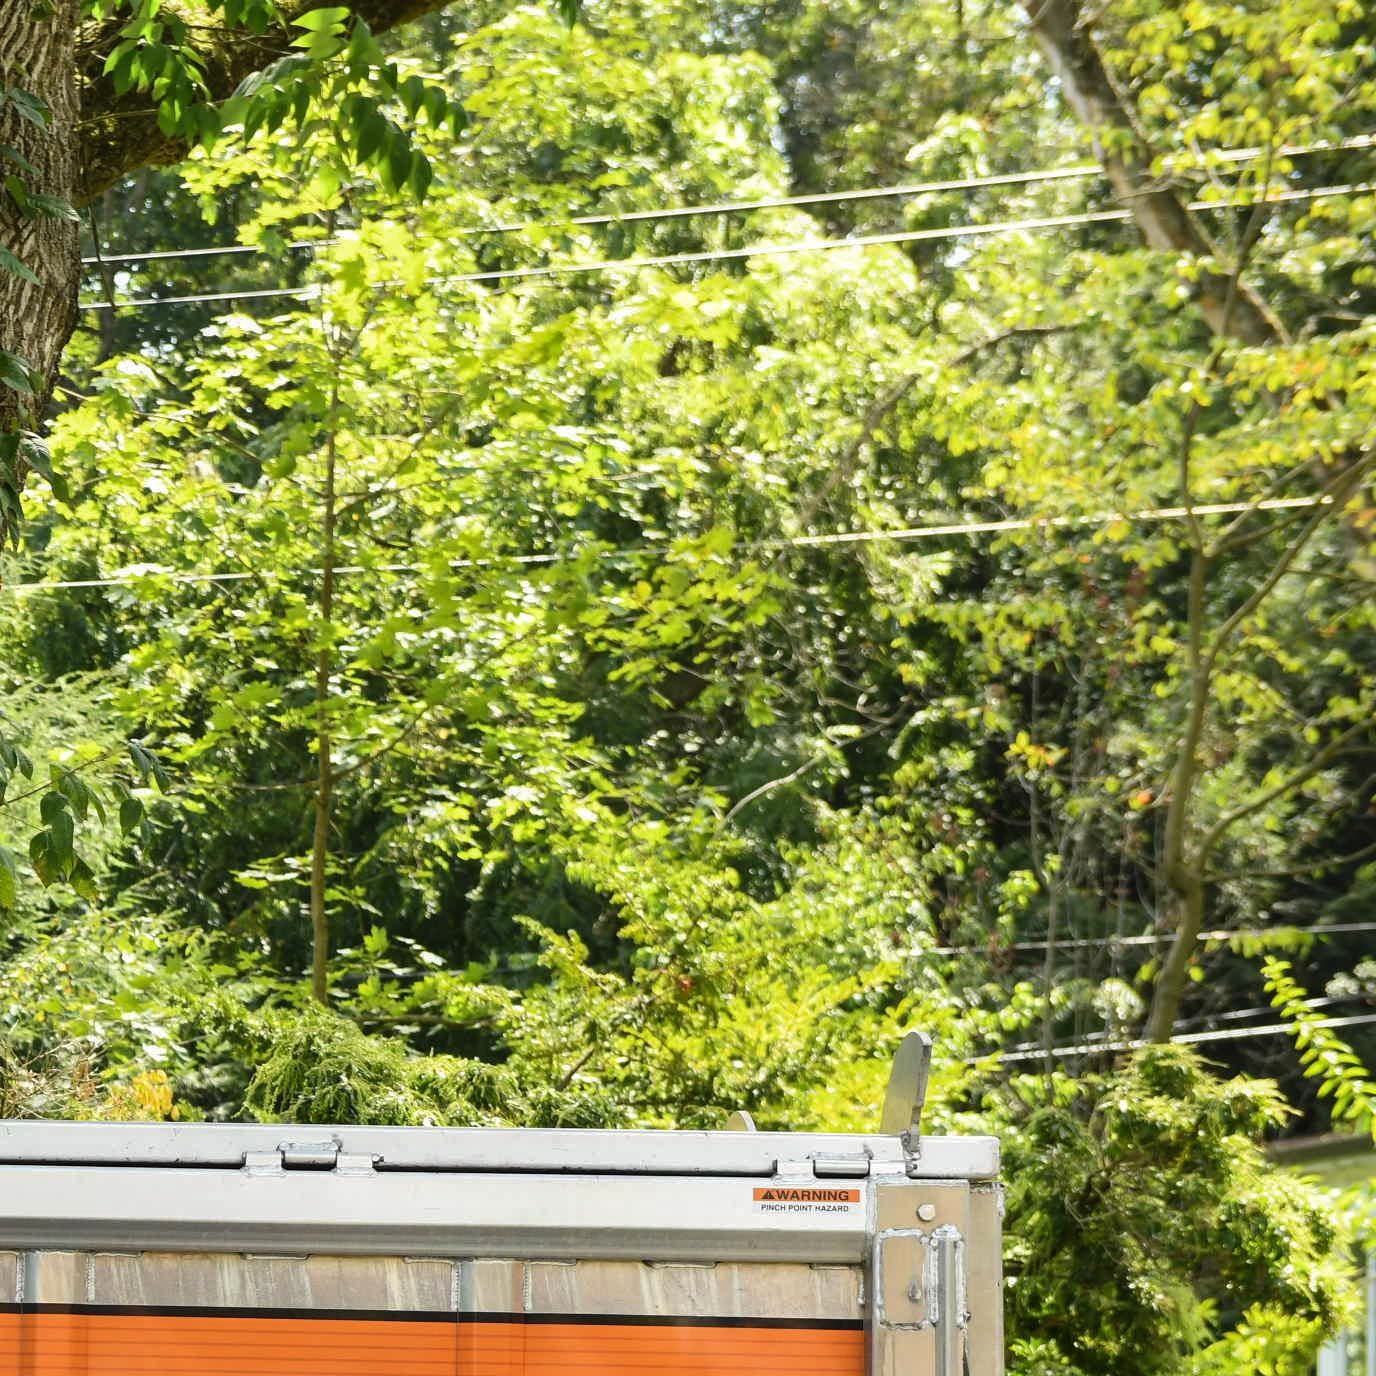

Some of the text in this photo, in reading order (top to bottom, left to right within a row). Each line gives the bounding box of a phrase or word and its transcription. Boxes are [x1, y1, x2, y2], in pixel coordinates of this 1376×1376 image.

[776, 1190, 849, 1201] WARNING
[788, 1204, 812, 1212] POINT
[815, 1205, 849, 1213] HAZARD
